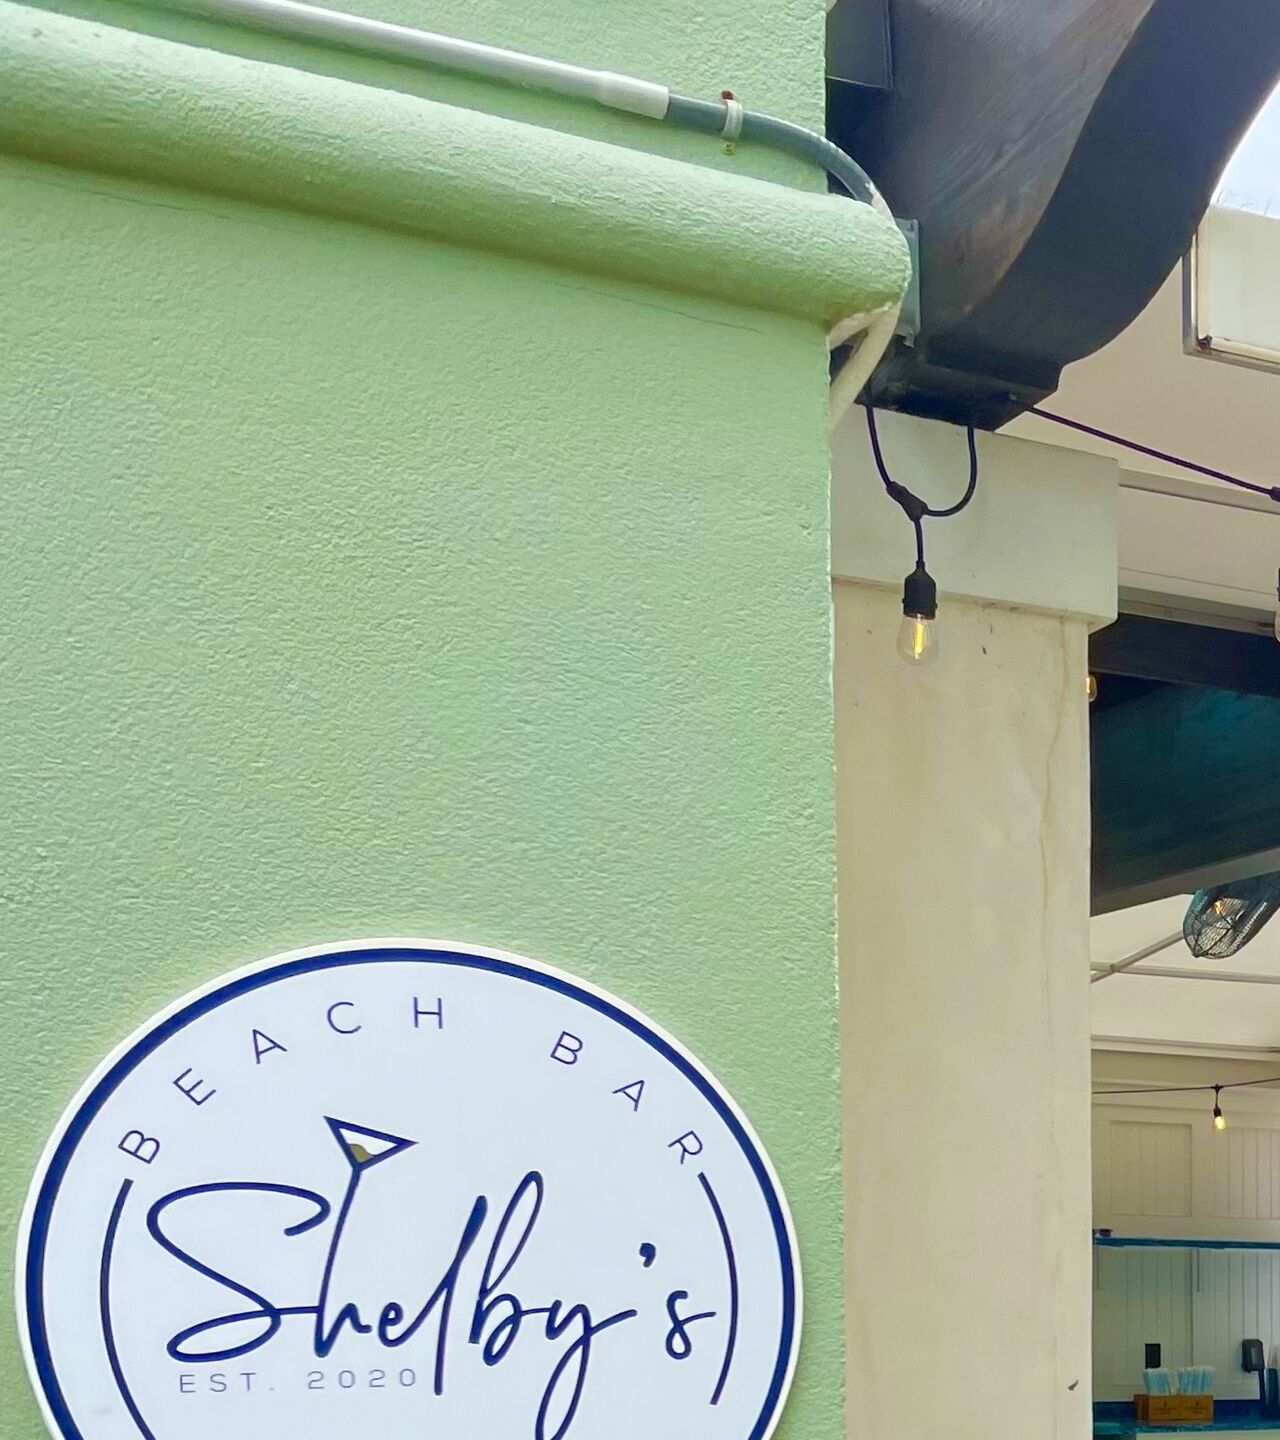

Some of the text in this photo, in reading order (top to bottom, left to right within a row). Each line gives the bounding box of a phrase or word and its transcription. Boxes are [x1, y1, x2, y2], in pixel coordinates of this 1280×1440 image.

[117, 996, 704, 1165] BEACH BAR
[179, 1368, 416, 1393] EST. 2020
